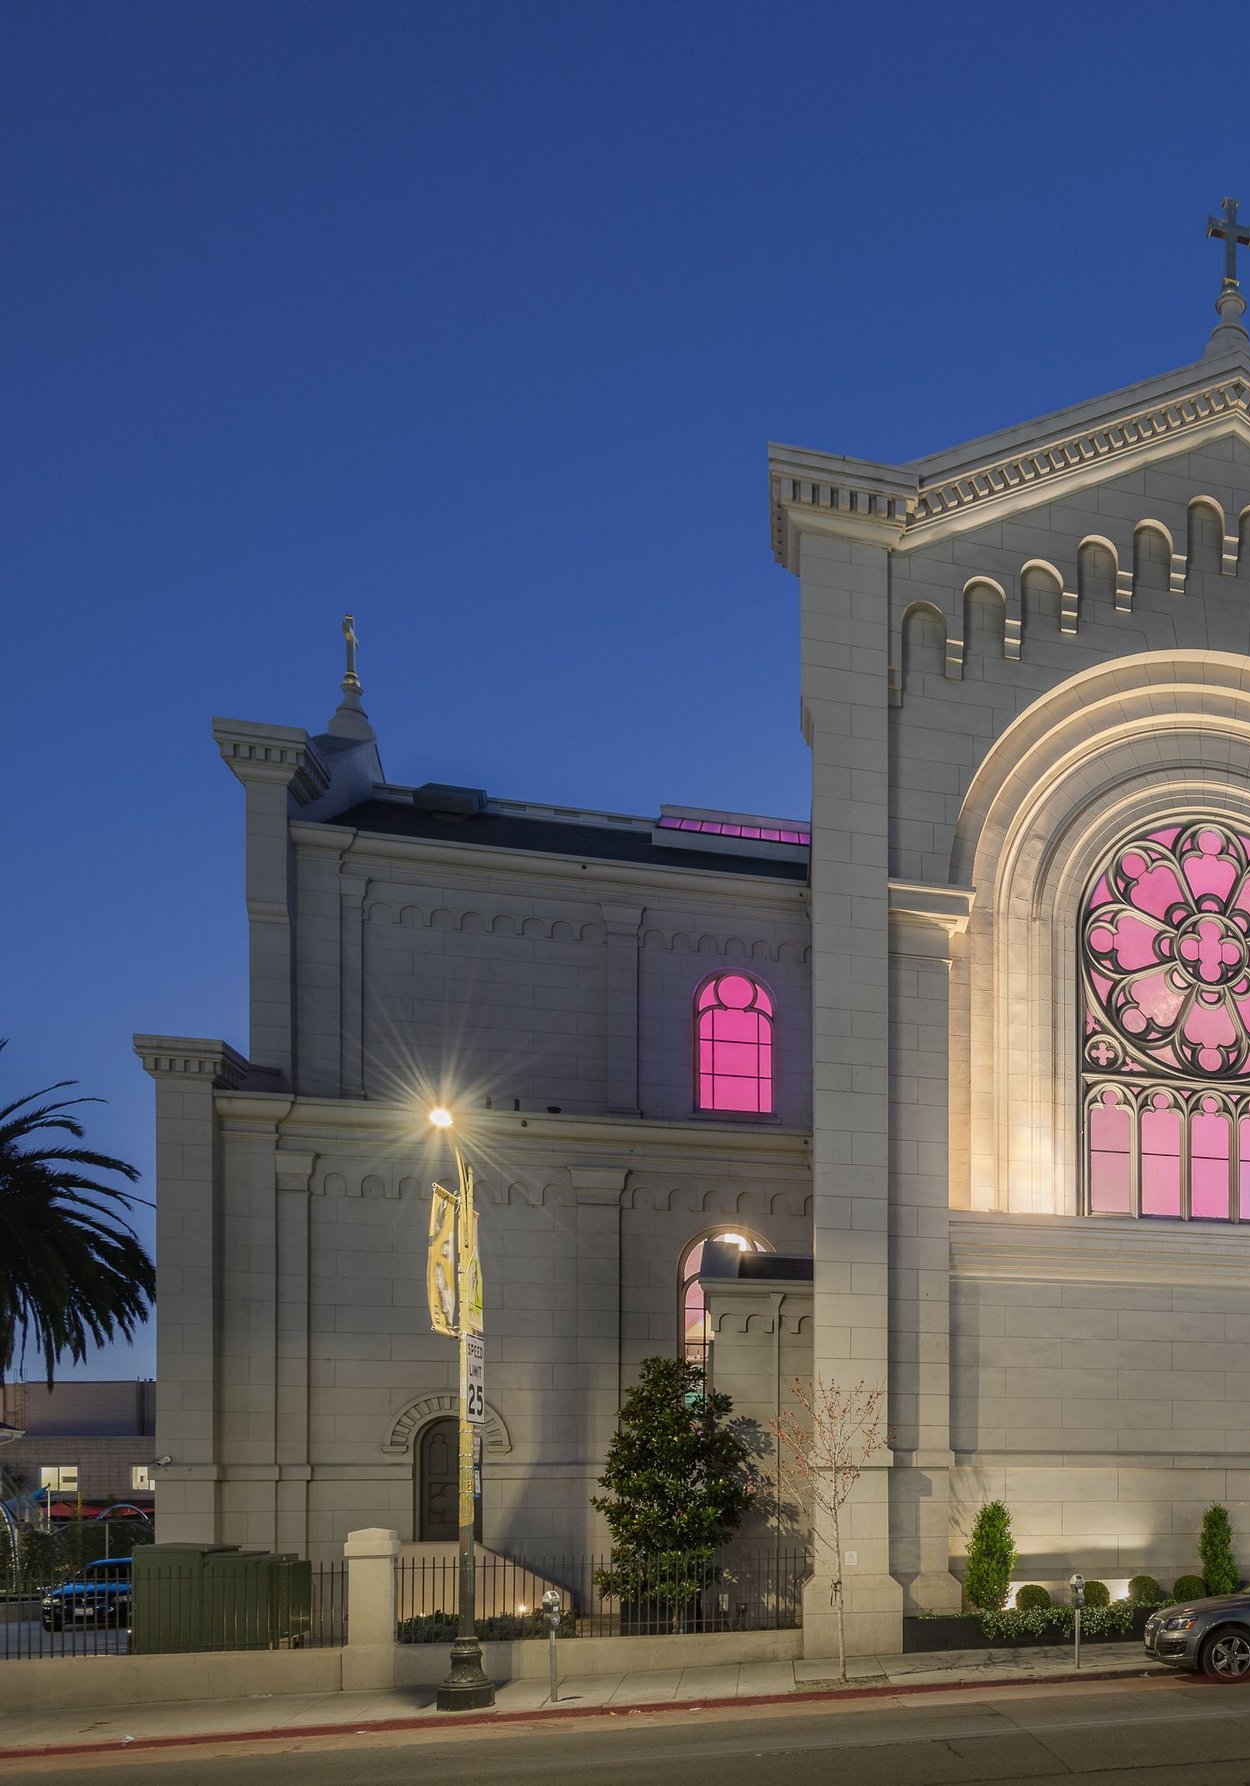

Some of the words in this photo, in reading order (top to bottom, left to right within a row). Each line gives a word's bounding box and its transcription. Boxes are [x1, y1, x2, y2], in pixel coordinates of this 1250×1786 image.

[468, 1343, 483, 1359] SPEED
[469, 1363, 482, 1378] LIMIT
[468, 1383, 483, 1416] 25
